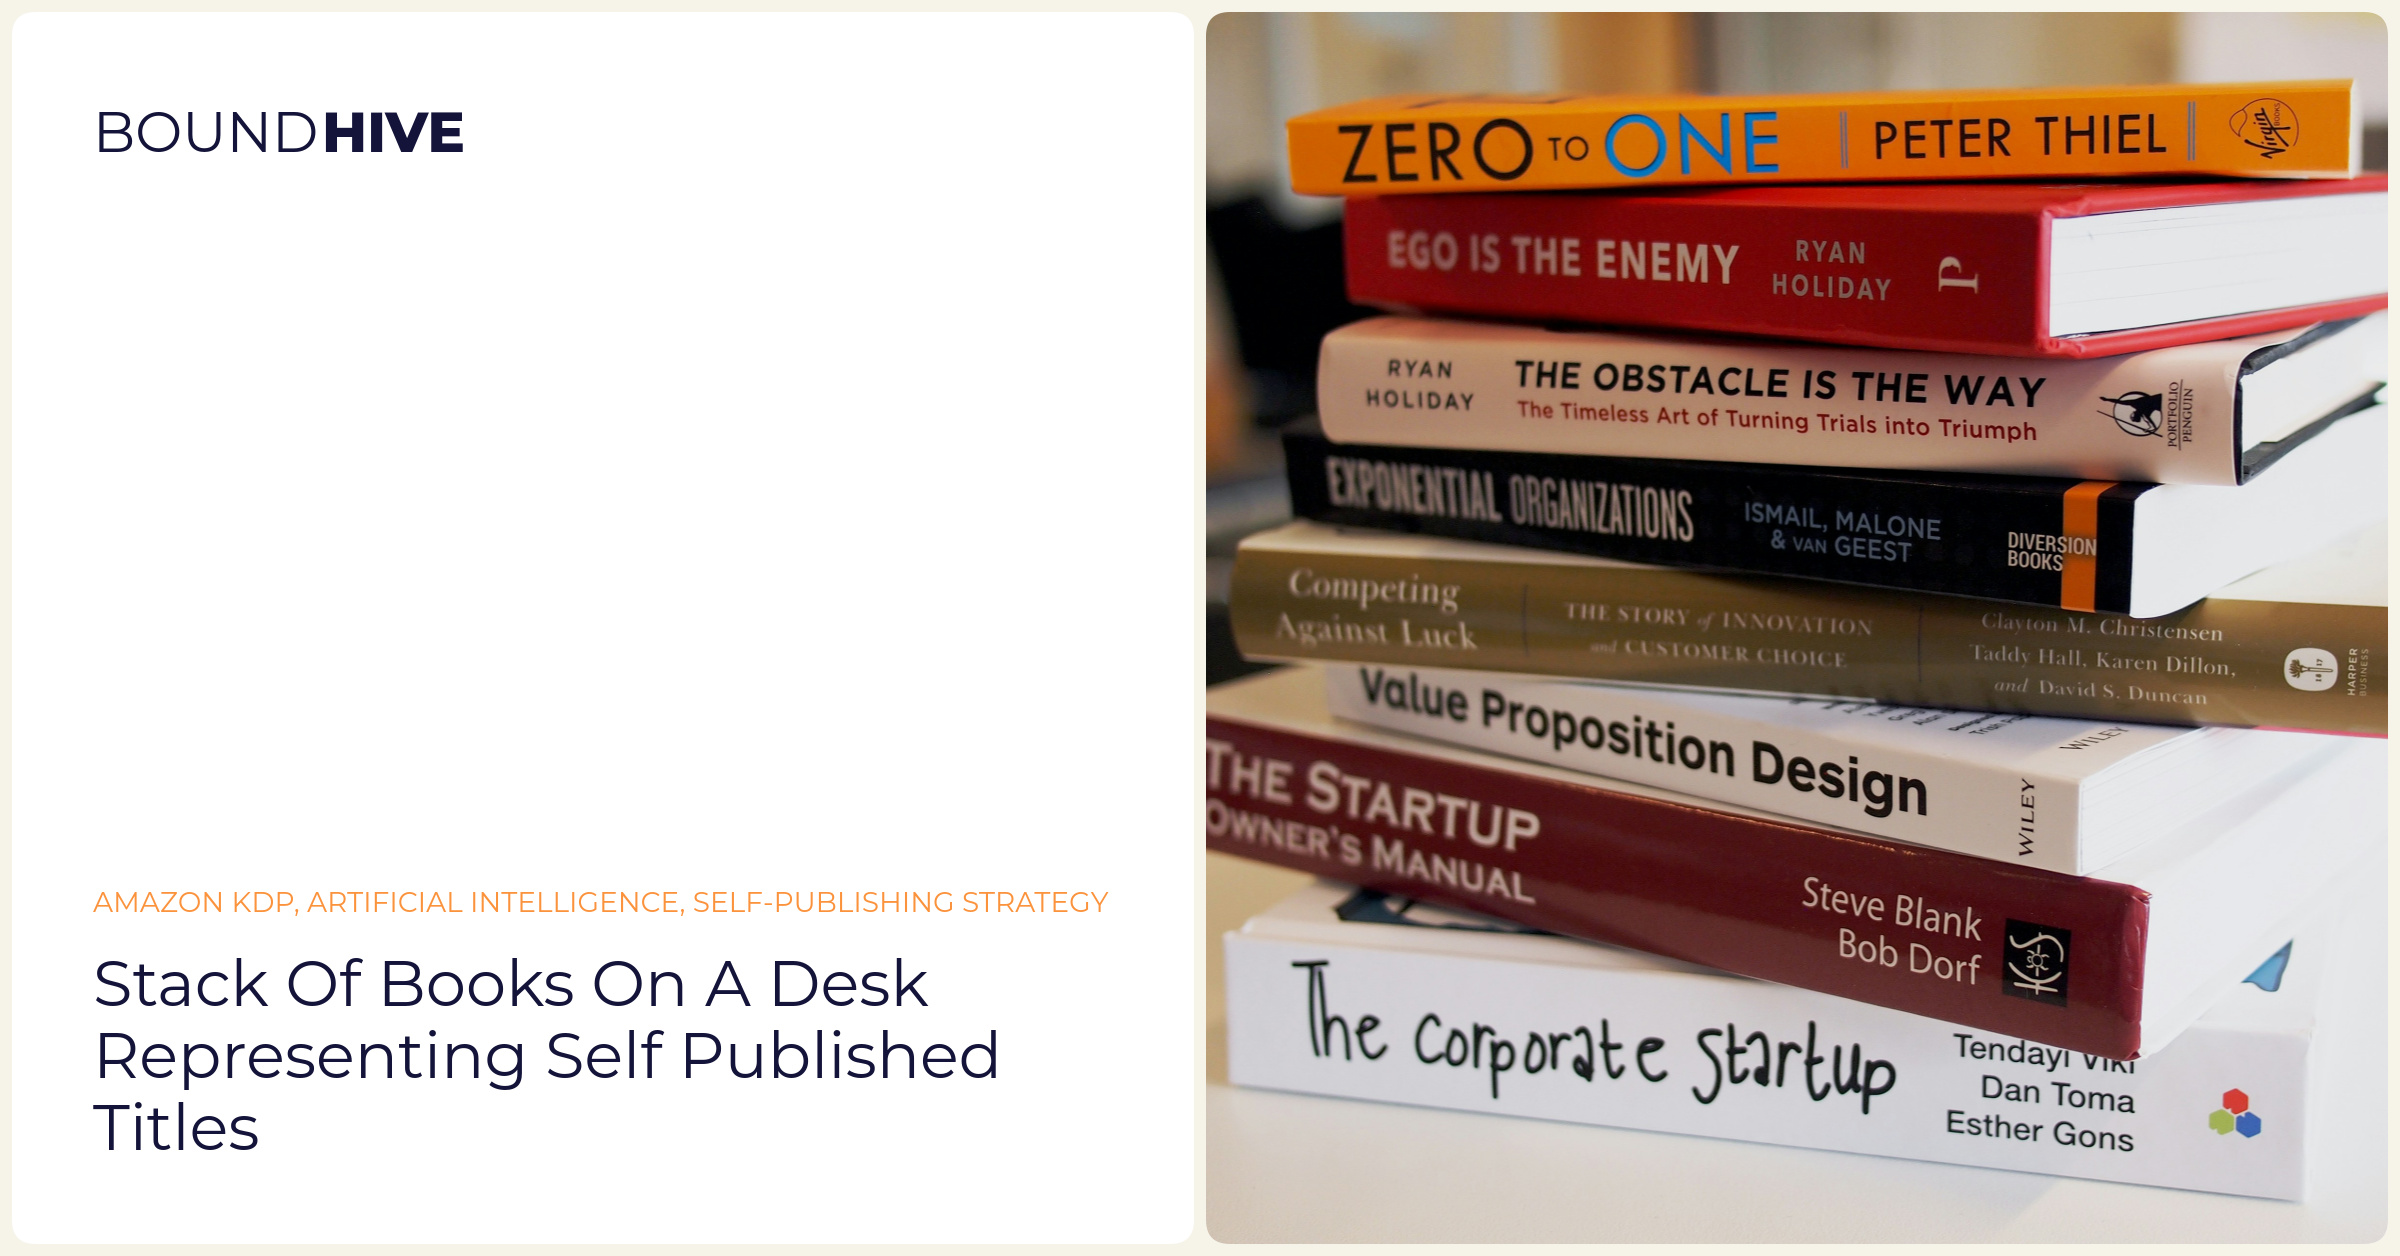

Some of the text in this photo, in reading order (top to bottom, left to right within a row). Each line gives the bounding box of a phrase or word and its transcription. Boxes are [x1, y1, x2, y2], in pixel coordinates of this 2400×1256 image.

[1875, 113, 2168, 160] PETER THIEL
[2244, 107, 2291, 160] Virgin
[2273, 102, 2281, 127] BOOKS
[1338, 111, 1780, 184] ZERO TO ONE
[1387, 230, 1740, 285] EGO IS THE ENEMY
[1796, 239, 1866, 265] RYAN
[1772, 272, 1892, 302] HOLIDAY
[1388, 358, 1453, 380] RYAN
[1515, 360, 2047, 408] THE OBSTACLE IS THE WAY
[1365, 388, 1475, 412] HOLIDAY
[1517, 400, 2038, 444] The Timeless Art of Turning Trials into Triumph
[2167, 381, 2179, 448] PORTFOLIO
[2182, 388, 2194, 443] PENGUIN
[1326, 456, 1695, 543] EXPONENTIAL ORGANIZATIONS
[1745, 501, 1942, 541] ISMAIL, MALONE
[1770, 529, 1912, 563] & VAN GEEST
[2007, 531, 2097, 557] DIVERSION
[2007, 549, 2065, 573] BOOKS
[1289, 567, 1461, 616] Competing
[1276, 611, 1479, 650] Against Luck
[1564, 602, 1611, 622] THE
[1617, 604, 1691, 627] STORY
[1723, 611, 1874, 636] INNOVATION
[1981, 611, 2223, 642] Clayton M. Christensen
[1624, 639, 1749, 664] CUSTOMER
[1757, 648, 1848, 669] CHOICE
[1969, 644, 2237, 678] Taddy Hall, Karen Dillon,
[2347, 647, 2358, 697] HARPER
[2359, 648, 2369, 697] BUSINESS
[1994, 677, 2208, 705] and David S. Duncan
[1360, 665, 1928, 819] Value Proposition Design
[2058, 725, 2130, 752] WILEY
[1206, 738, 1541, 852] THE STARTUP
[2018, 778, 2037, 858] WILEY
[1206, 797, 1537, 905] OWNER'S MANUAL
[1802, 875, 1983, 942] Steve Blank
[1839, 927, 1983, 986] Bob Dorf
[1292, 959, 1388, 1061] The
[1982, 1074, 2135, 1114] Dan Toma
[1947, 1109, 2134, 1152] Esther Gons
